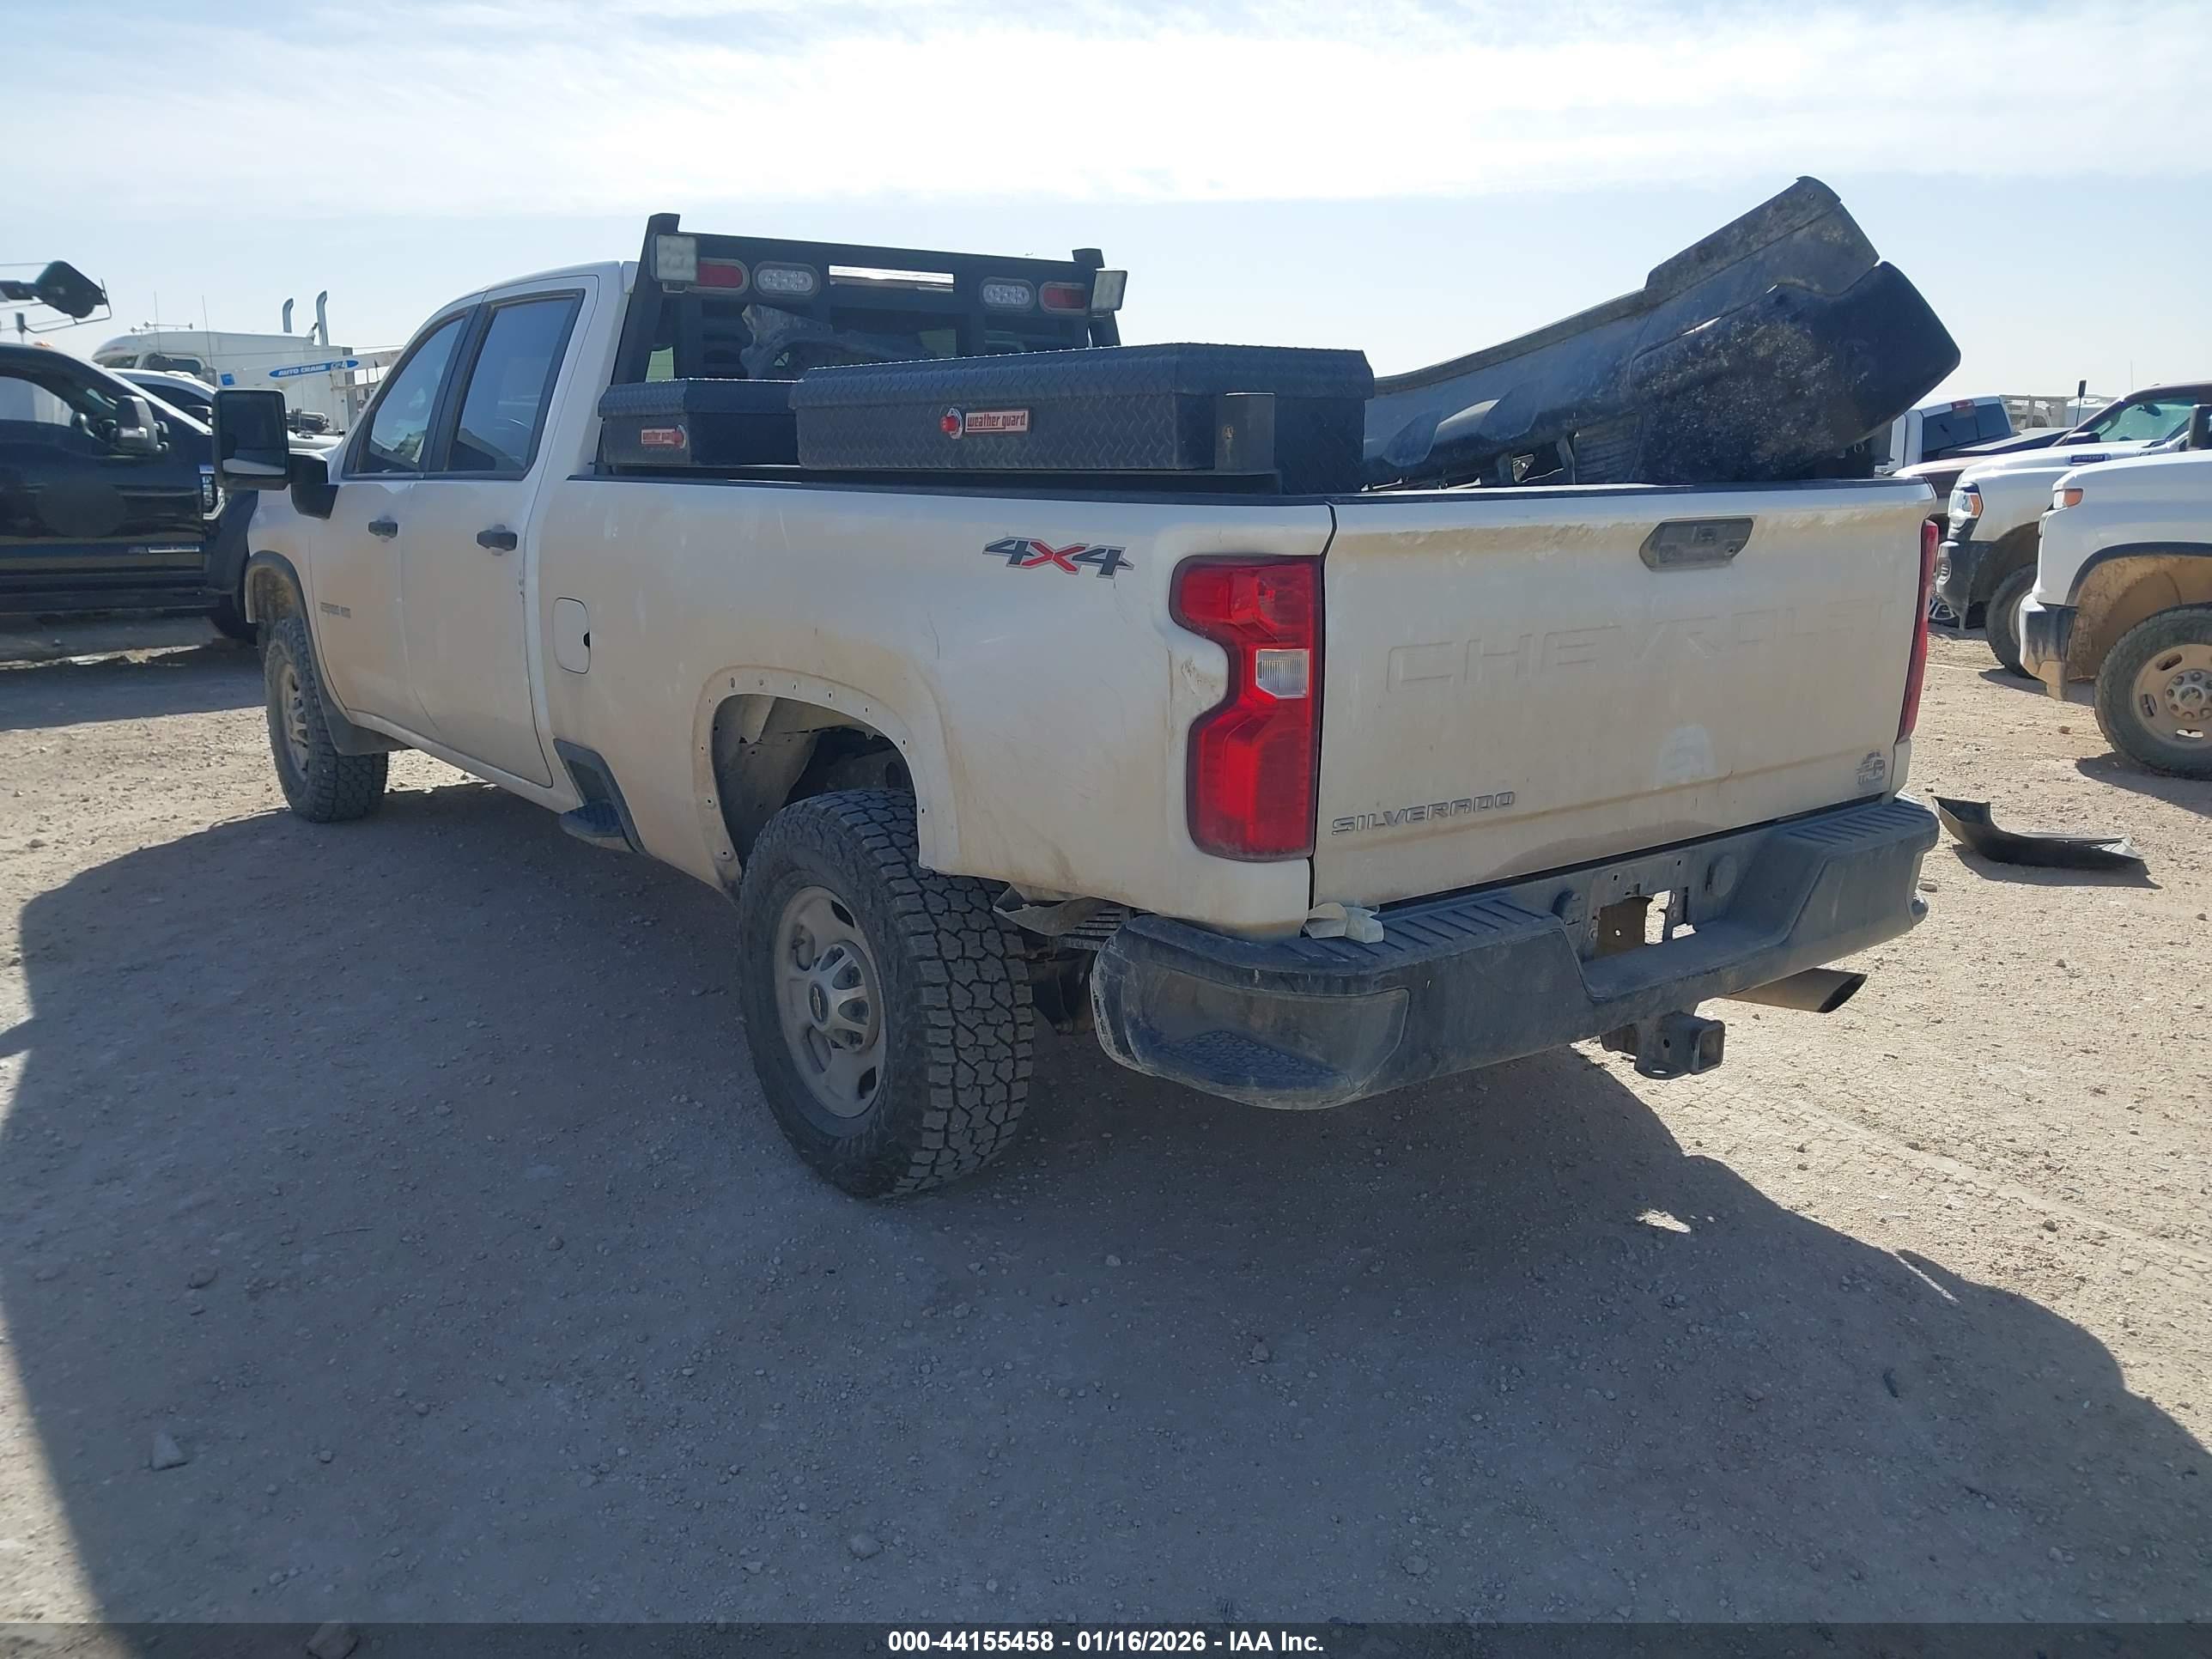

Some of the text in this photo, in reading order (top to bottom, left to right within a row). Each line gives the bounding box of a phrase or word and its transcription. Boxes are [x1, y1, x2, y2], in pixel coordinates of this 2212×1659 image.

[967, 411, 1026, 428] weather guard
[1332, 791, 1516, 836] SILVERADO
